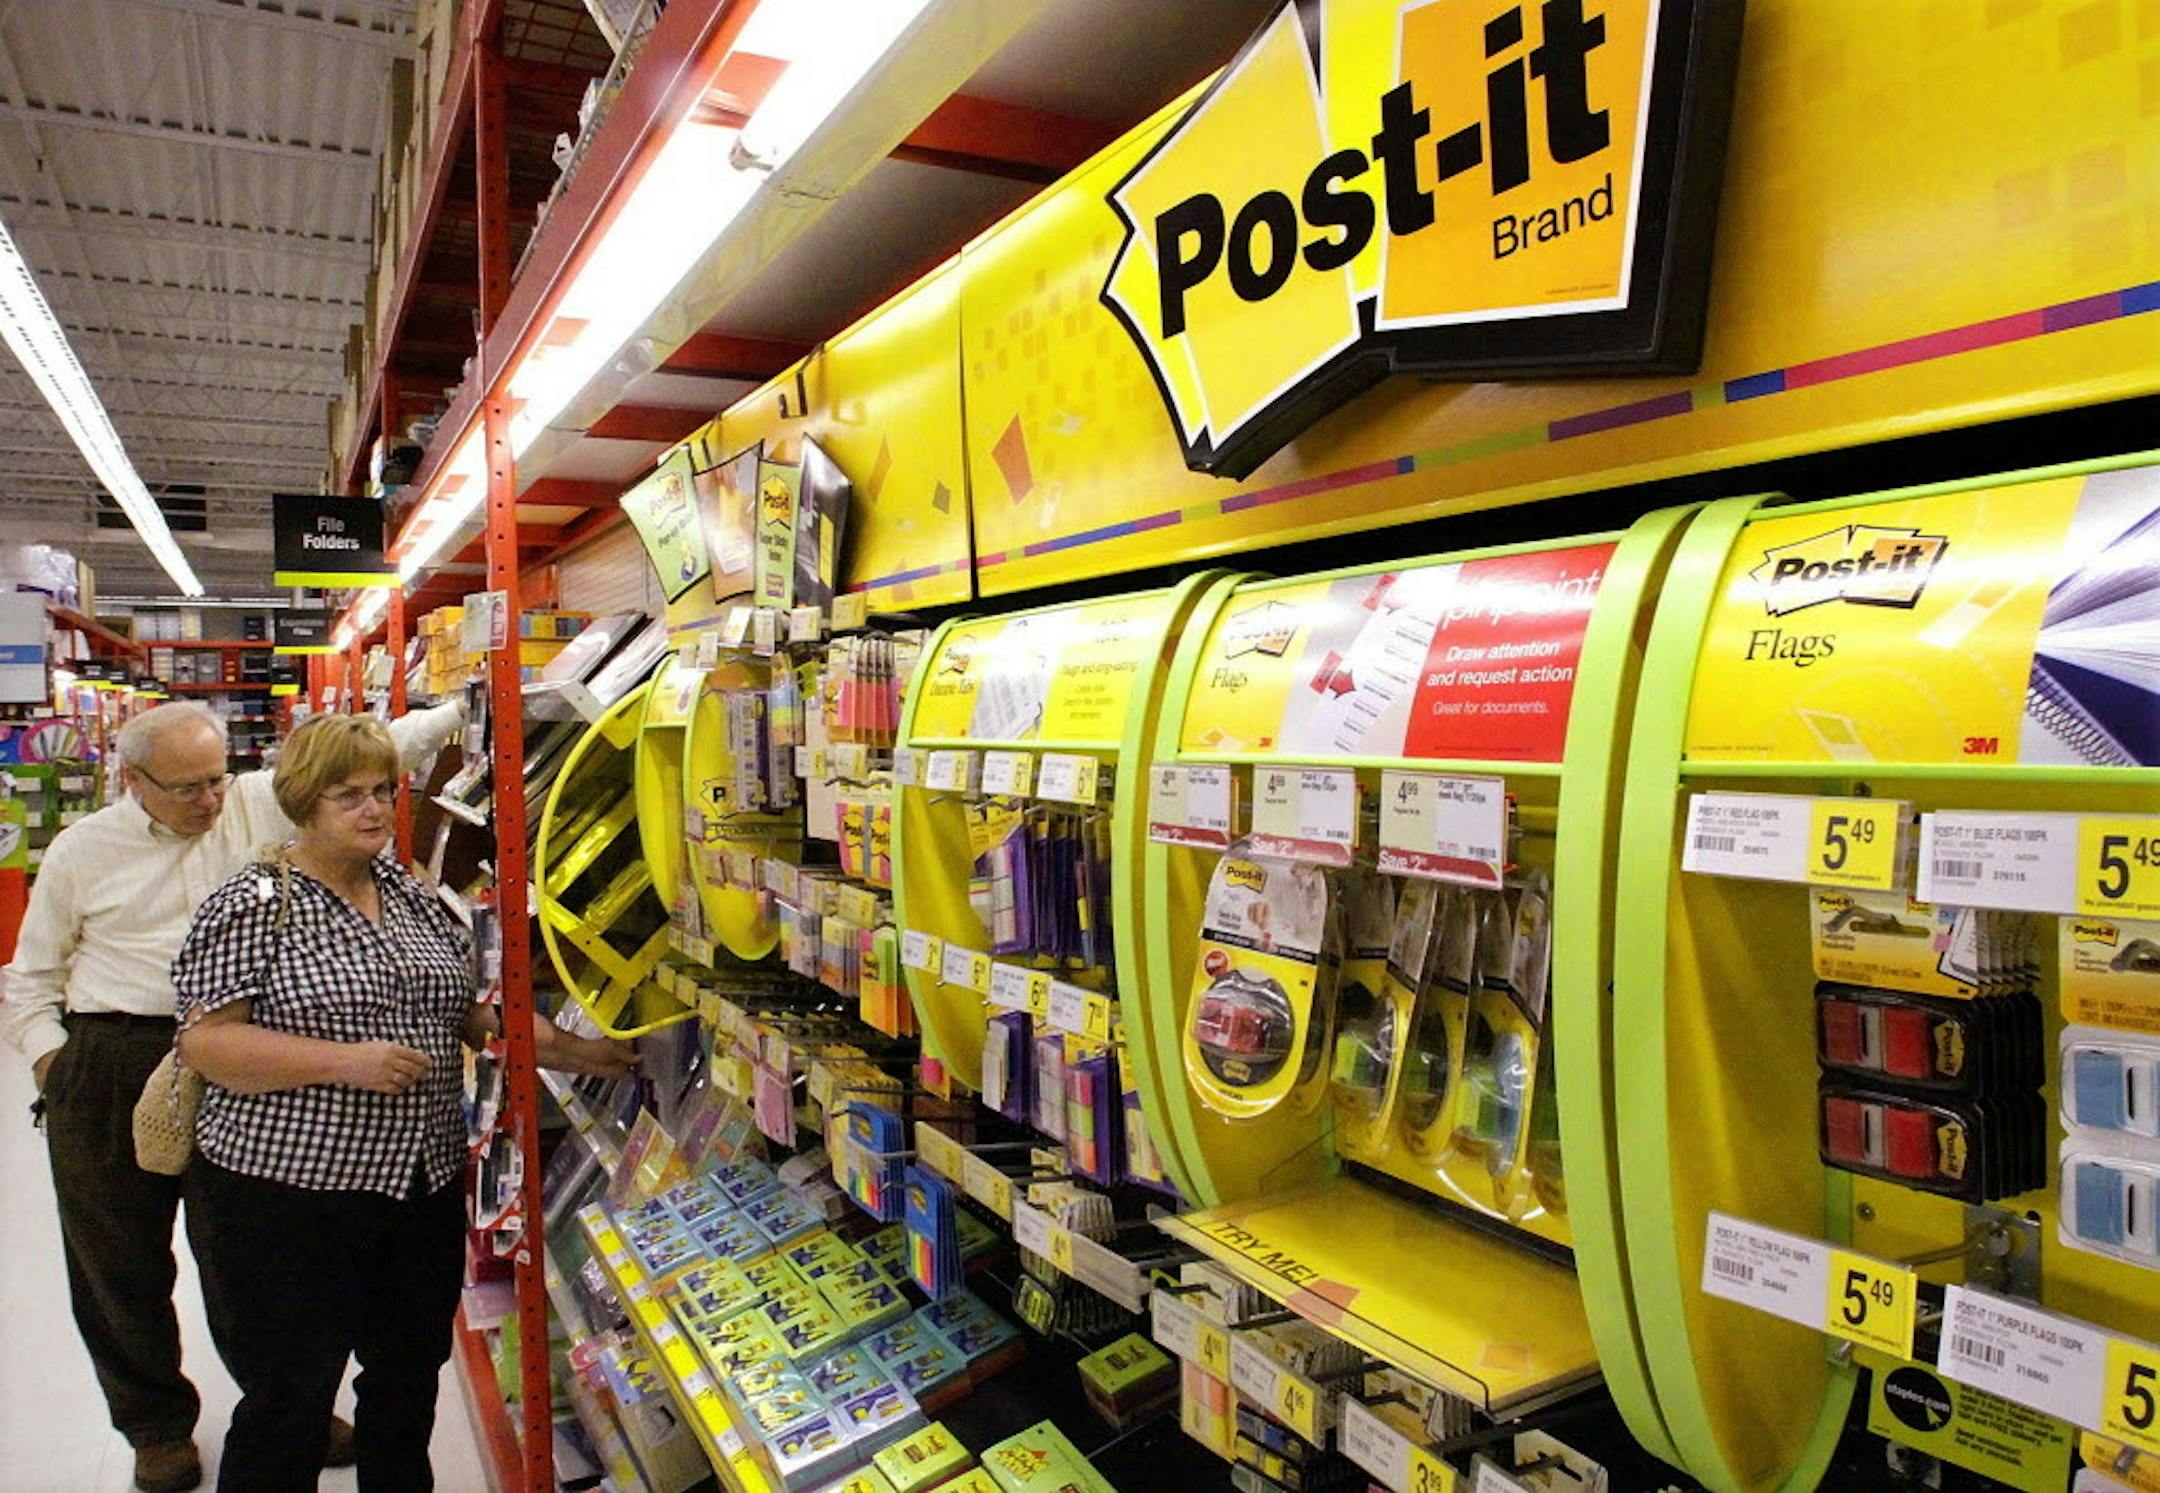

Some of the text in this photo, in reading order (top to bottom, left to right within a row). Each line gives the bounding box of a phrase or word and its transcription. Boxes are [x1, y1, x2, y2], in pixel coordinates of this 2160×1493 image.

[1155, 0, 1610, 340] Post-it
[1492, 173, 1615, 260] Brand
[317, 516, 346, 533] File
[302, 533, 361, 551] Folders
[1771, 544, 1924, 586] Post-it
[1445, 640, 1562, 662] Draw attention
[1744, 628, 1837, 667] Flags
[1210, 667, 1248, 694] Flags
[1426, 665, 1573, 690] and request action
[1432, 699, 1550, 716] Great for documents.
[1963, 737, 1999, 755] 3M
[1974, 828, 1995, 840] BLUE
[1226, 865, 1265, 885] Post-it
[1214, 1221, 1320, 1285] TRY ME!
[1996, 1313, 2030, 1337] PURPLE
[2030, 1324, 2058, 1344] FLAGS
